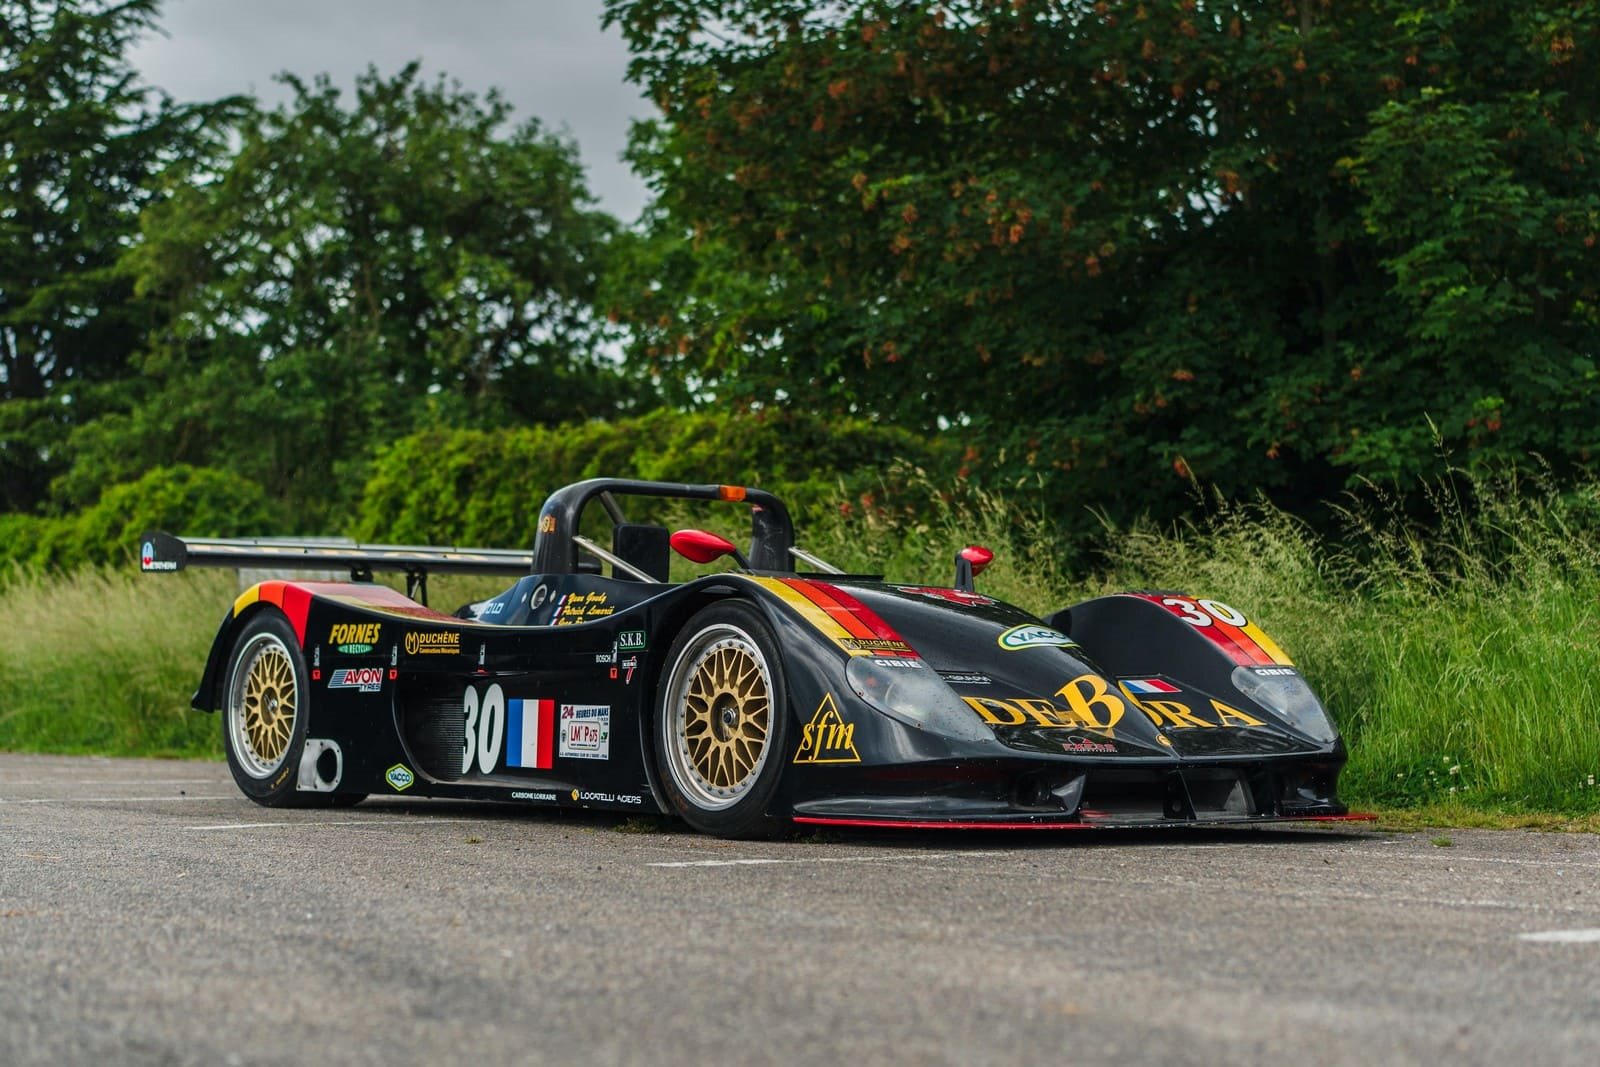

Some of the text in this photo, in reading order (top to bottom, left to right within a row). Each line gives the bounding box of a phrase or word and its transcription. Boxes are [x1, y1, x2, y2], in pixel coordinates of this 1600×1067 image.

[1162, 599, 1248, 627] 30
[328, 623, 381, 644] FORNES
[419, 630, 460, 644] DUCHÊNE
[620, 632, 644, 647] S.K.B.
[1011, 631, 1067, 641] YACCO
[595, 654, 611, 663] BOSCH
[343, 668, 383, 684] AVON
[562, 705, 575, 719] 24
[462, 683, 505, 774] 30
[801, 710, 855, 762] sfm
[390, 772, 411, 782] YACCO
[511, 791, 557, 801] CARBONE LORRAINE
[580, 791, 615, 802] LOCATELLI
